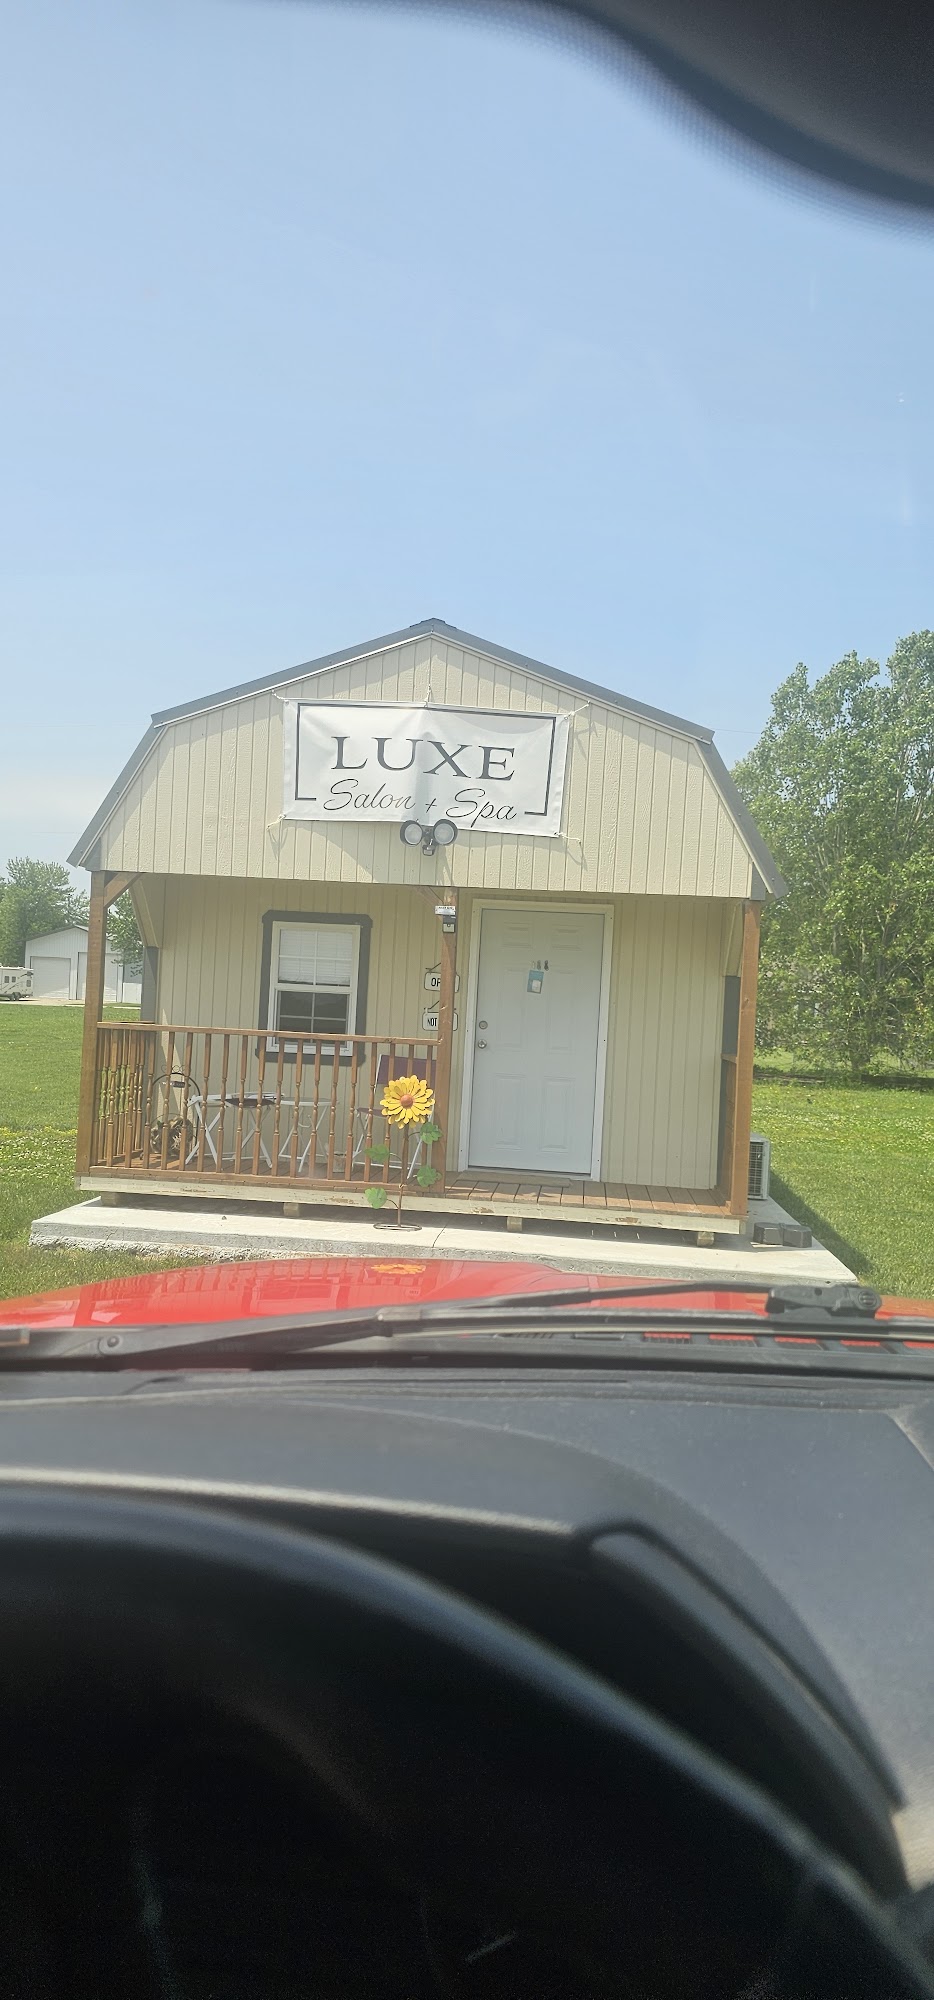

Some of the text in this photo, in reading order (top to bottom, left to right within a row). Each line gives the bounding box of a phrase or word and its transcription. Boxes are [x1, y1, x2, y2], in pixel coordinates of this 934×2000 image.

[331, 736, 516, 781] LUXE
[323, 778, 517, 828] Salon + Spa
[427, 1017, 438, 1027] NOT
